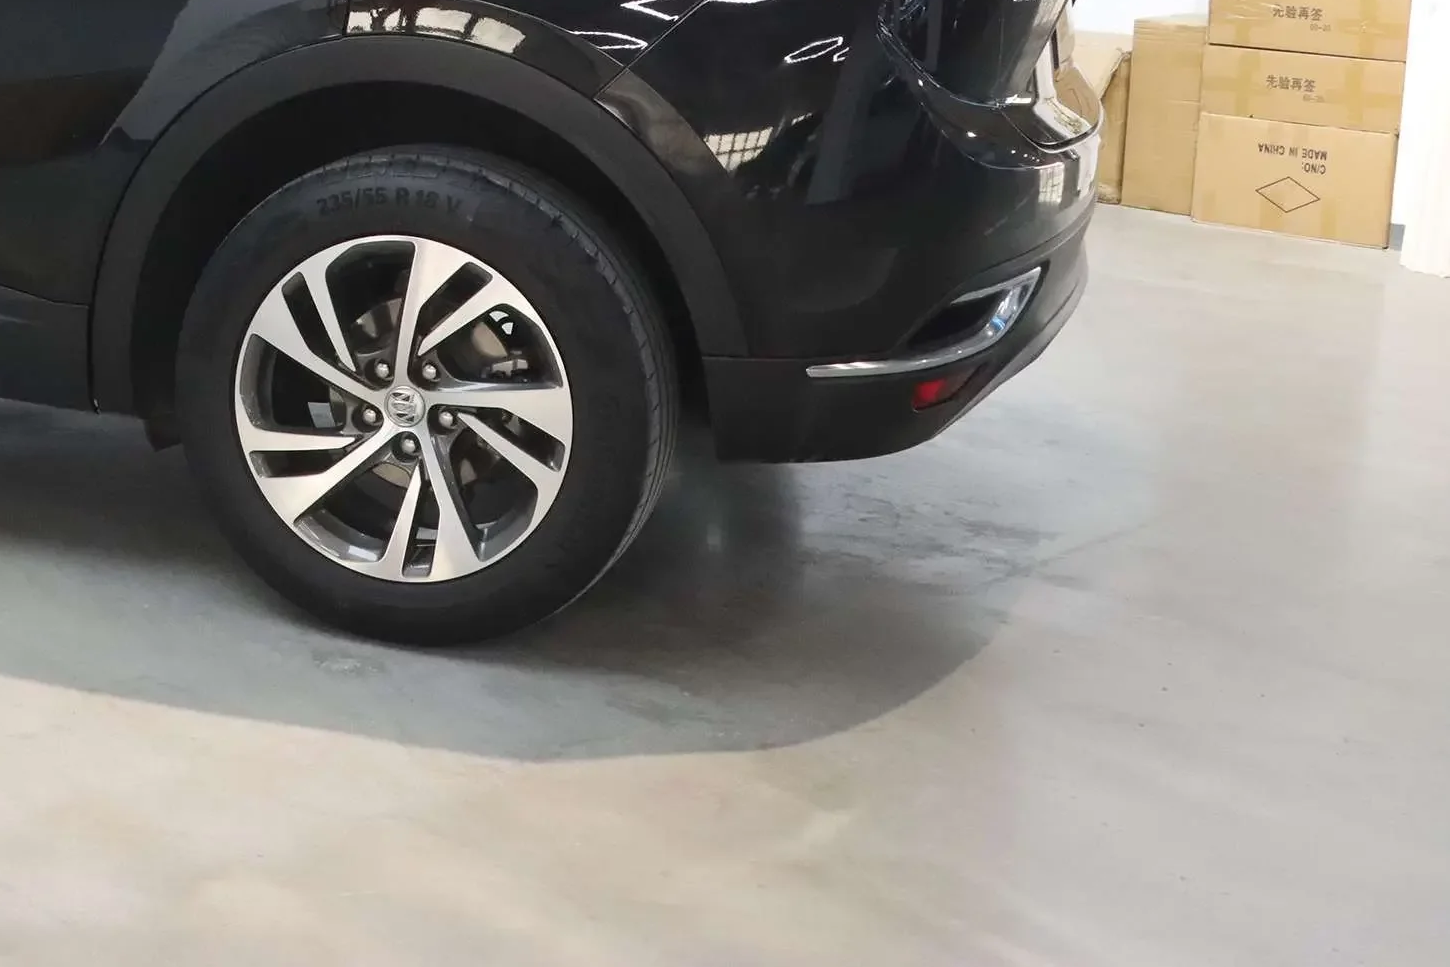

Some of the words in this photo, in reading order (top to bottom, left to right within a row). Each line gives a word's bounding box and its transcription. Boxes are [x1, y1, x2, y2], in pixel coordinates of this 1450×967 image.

[1265, 74, 1316, 93] 先验再签
[1257, 143, 1286, 156] CHINA
[1289, 146, 1298, 158] IN
[1302, 148, 1328, 161] MADE
[395, 187, 410, 207] R
[415, 190, 439, 209] 18
